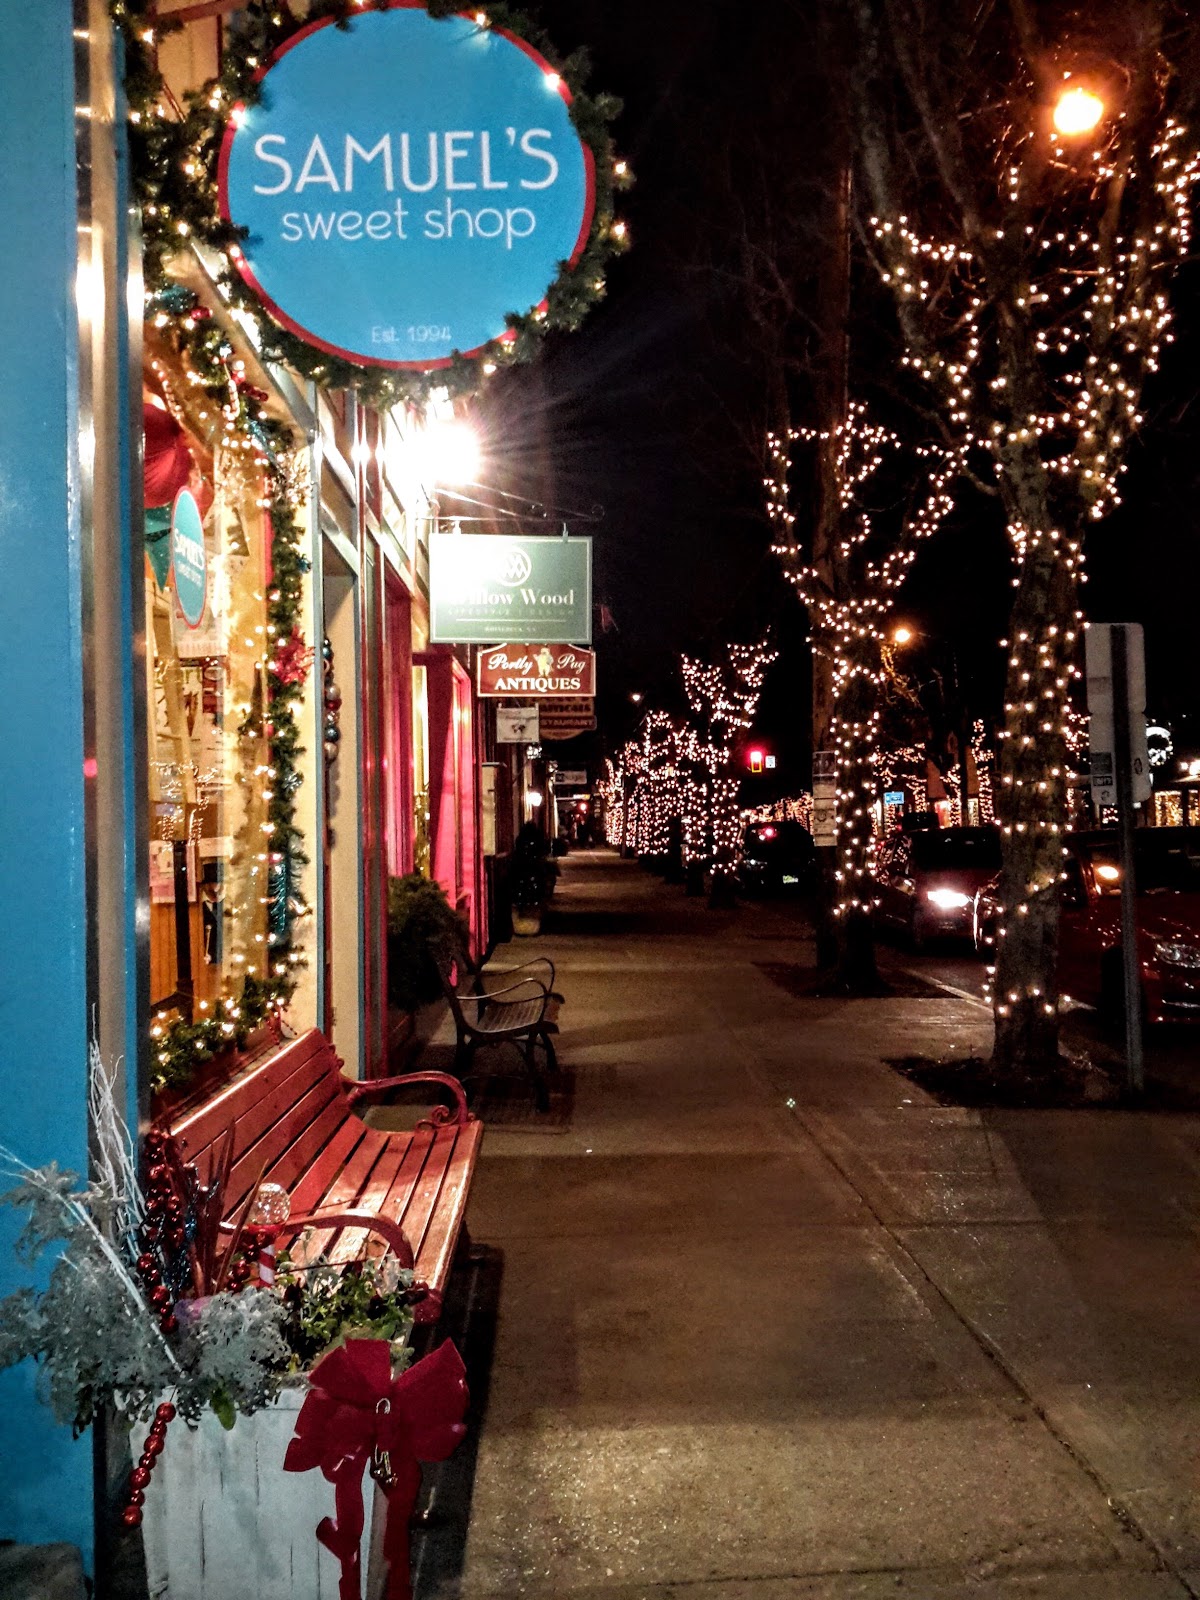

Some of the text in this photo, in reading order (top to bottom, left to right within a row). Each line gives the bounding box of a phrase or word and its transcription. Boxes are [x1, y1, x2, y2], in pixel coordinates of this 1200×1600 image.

[254, 127, 559, 195] SAMUEL'S
[281, 197, 536, 250] sweet shop
[407, 325, 452, 341] 1994
[520, 588, 574, 605] Wood
[487, 653, 586, 675] Portly Pug
[494, 677, 581, 692] ANTIQUES
